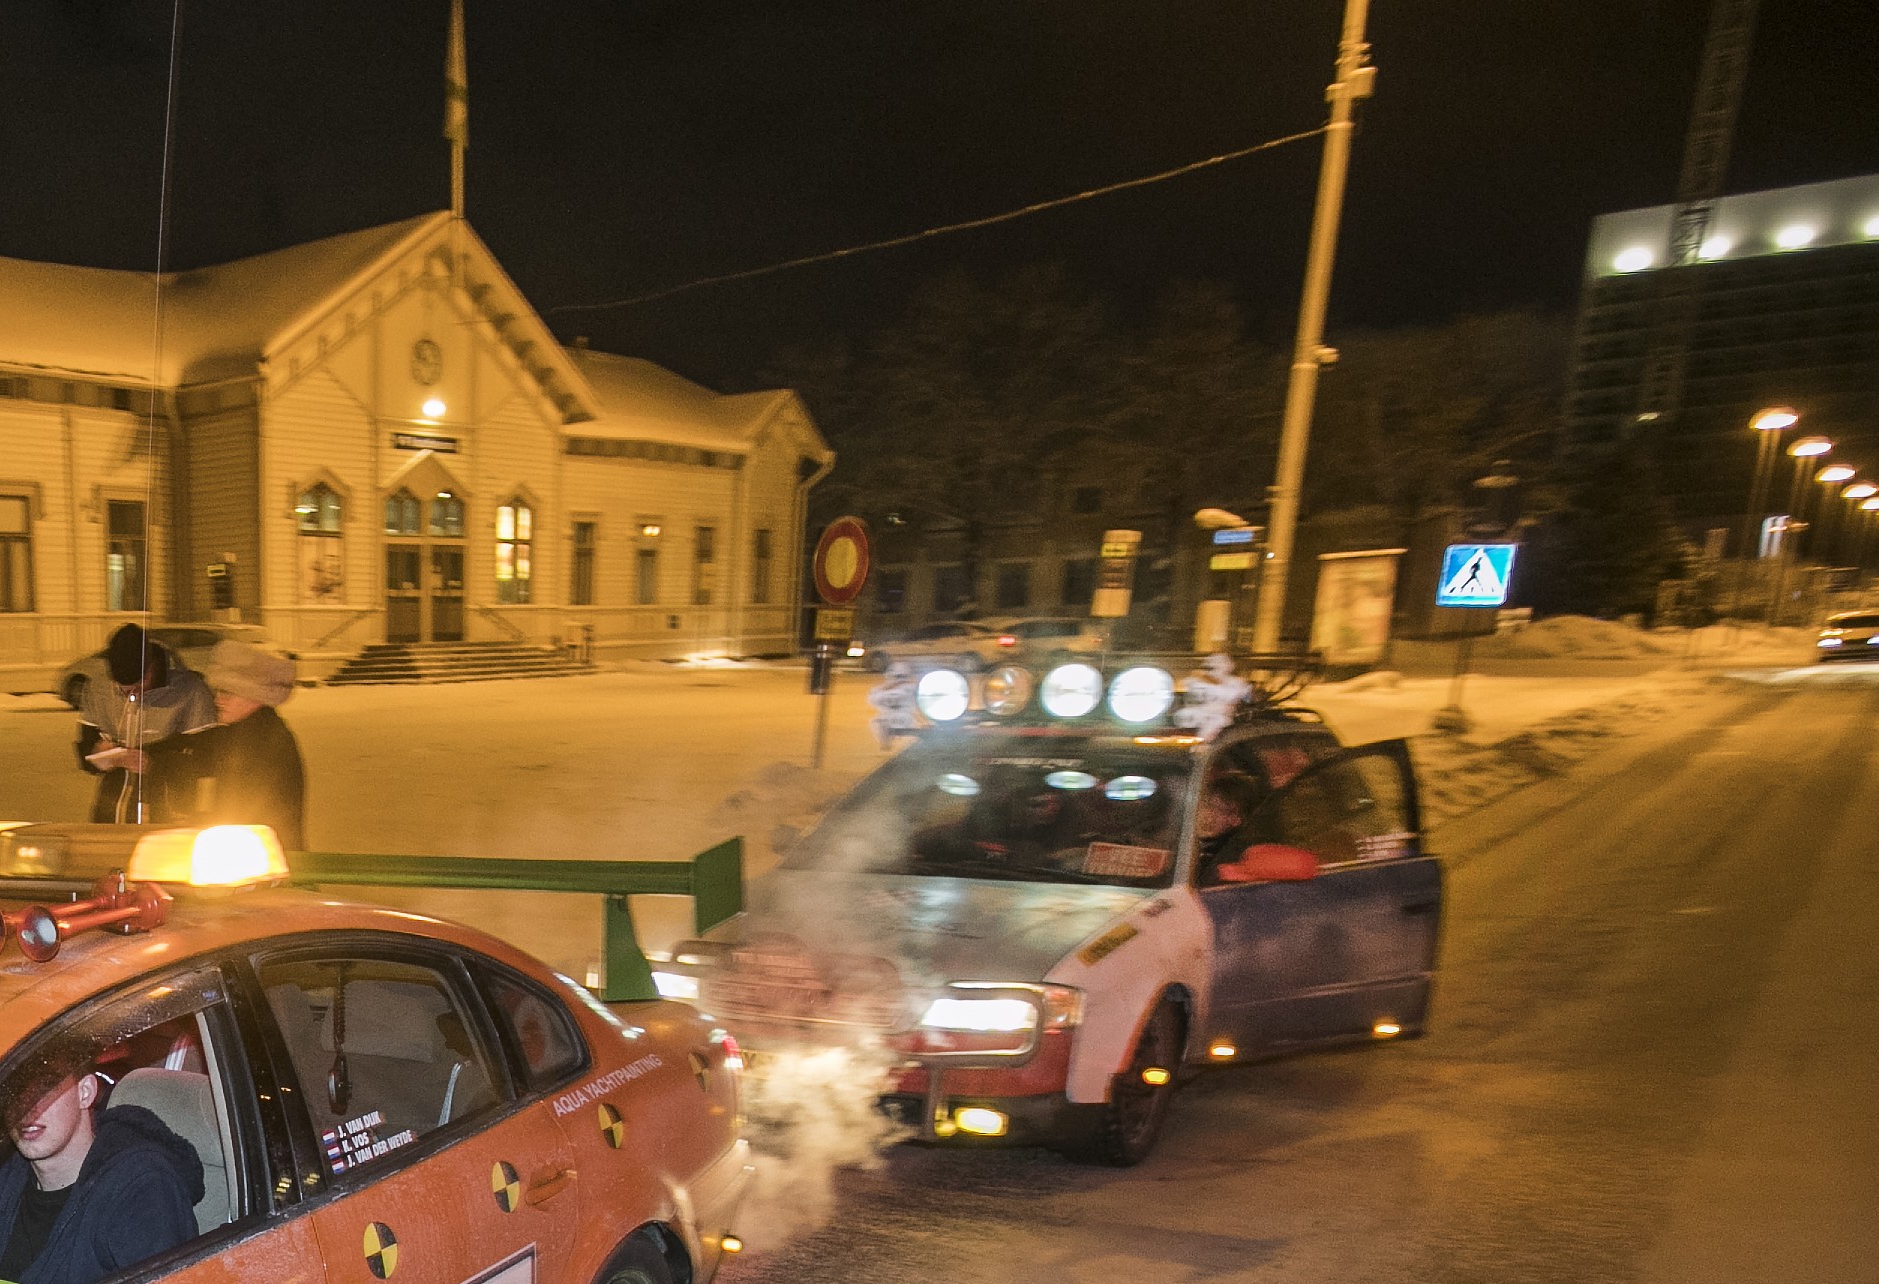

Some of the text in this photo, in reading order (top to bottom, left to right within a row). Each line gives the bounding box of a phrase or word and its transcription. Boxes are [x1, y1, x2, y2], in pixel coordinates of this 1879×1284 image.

[552, 1053, 663, 1117] AQUA YACHTPAINTING
[338, 1126, 346, 1138] J.
[346, 1118, 364, 1133] VAN
[342, 1133, 369, 1152] K. VOS
[347, 1130, 412, 1167] J. VAN DER WEYDE
